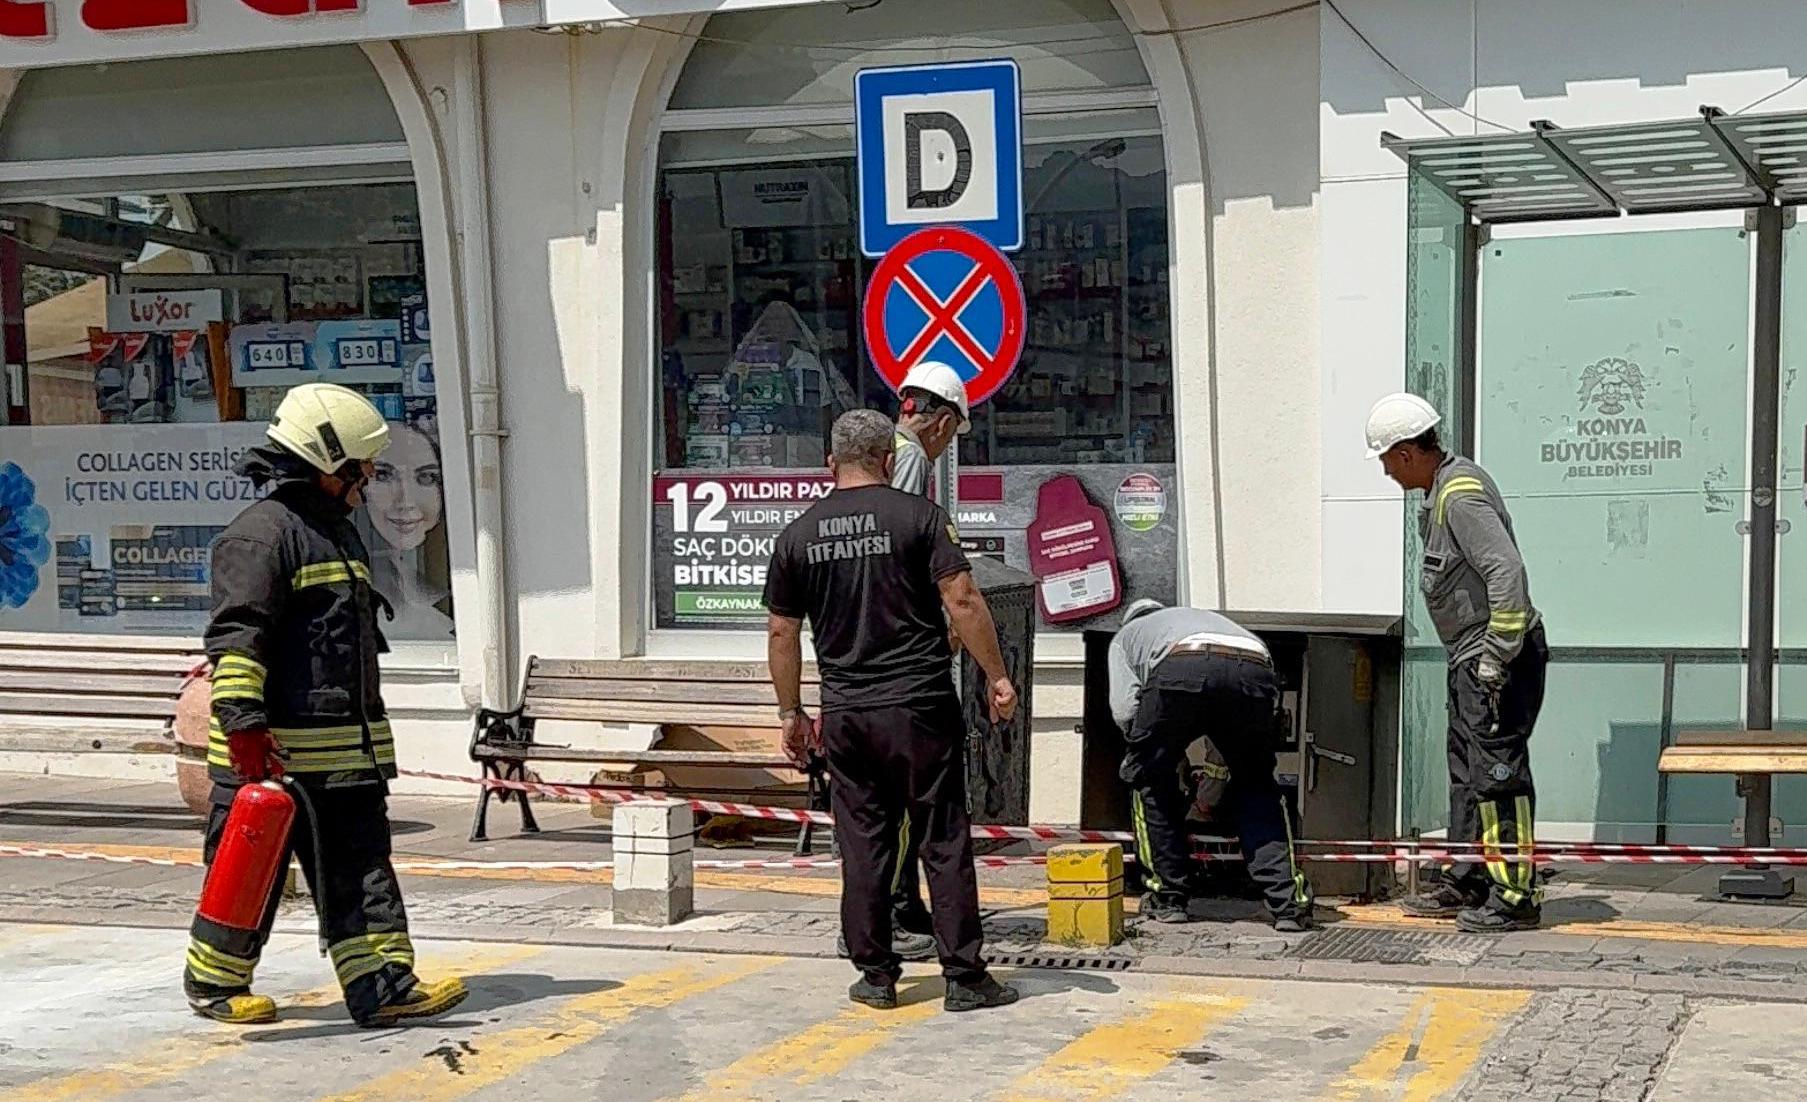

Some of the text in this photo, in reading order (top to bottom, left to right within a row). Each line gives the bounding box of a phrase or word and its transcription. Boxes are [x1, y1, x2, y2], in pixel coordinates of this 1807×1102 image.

[904, 112, 972, 209] D
[252, 347, 285, 362] 640
[343, 345, 376, 360] 830
[1576, 418, 1647, 436] KONYA
[77, 447, 247, 472] COLLAGEN SERİS
[1541, 436, 1682, 462] BÜYÜKŞEHİR
[1567, 464, 1653, 478] BELEDİYESİ
[65, 477, 126, 506] İÇTEN
[132, 480, 198, 501] GELEN
[667, 482, 729, 532] 12
[730, 482, 793, 499] YILDIR
[732, 511, 780, 524] YILDIR
[818, 513, 877, 538] KONYA
[674, 538, 716, 561] SAÇ
[806, 530, 892, 565] İTFAİYESİ
[674, 559, 767, 586] BİTKİSE
[696, 598, 762, 610] ÖZKAYNAK
